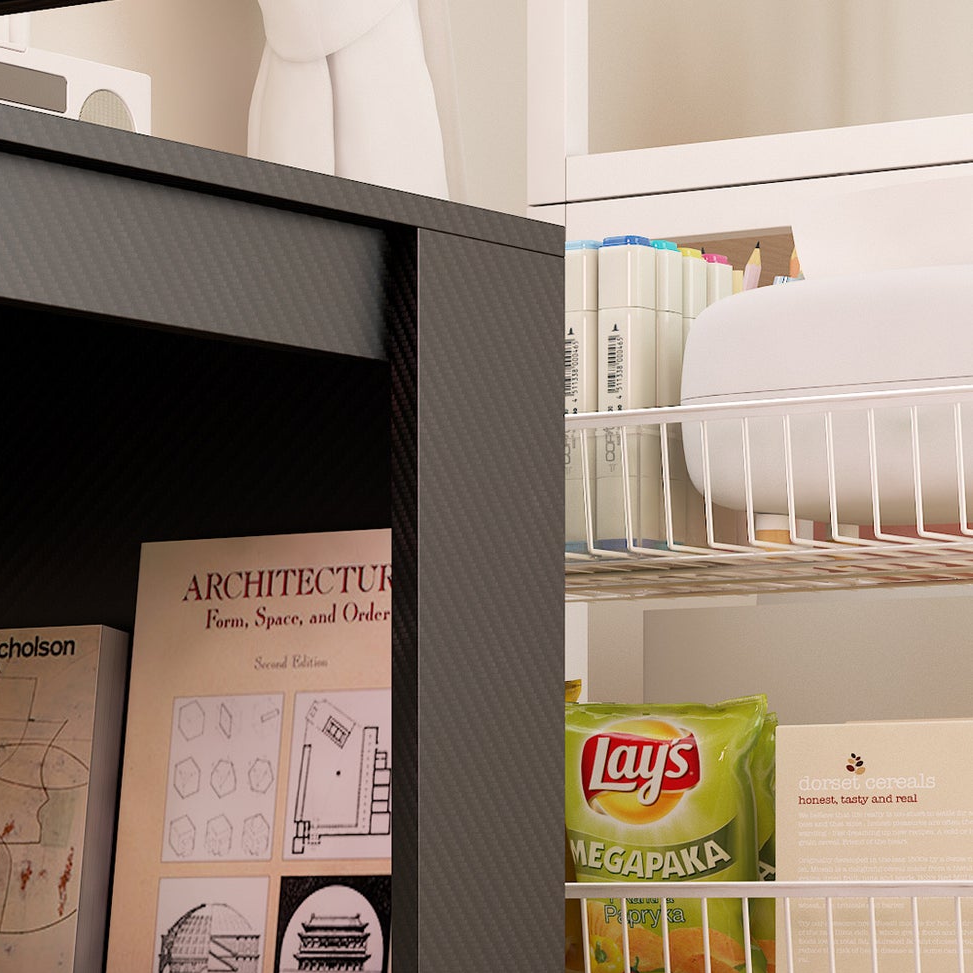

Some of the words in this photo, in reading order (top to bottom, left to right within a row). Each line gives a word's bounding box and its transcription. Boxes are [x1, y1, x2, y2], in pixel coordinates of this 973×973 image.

[205, 608, 249, 629] Form,
[255, 606, 303, 630] Space,
[309, 603, 336, 624] and
[343, 601, 391, 622] Order
[254, 655, 287, 670] Second
[292, 654, 328, 669] Edition
[588, 736, 693, 806] Lay's
[799, 775, 861, 791] dorset
[865, 773, 936, 790] cereals
[798, 796, 839, 805] honest,
[841, 796, 869, 806] tasty
[871, 794, 893, 804] and
[896, 794, 918, 803] real
[570, 839, 732, 879] MEGAPAKA
